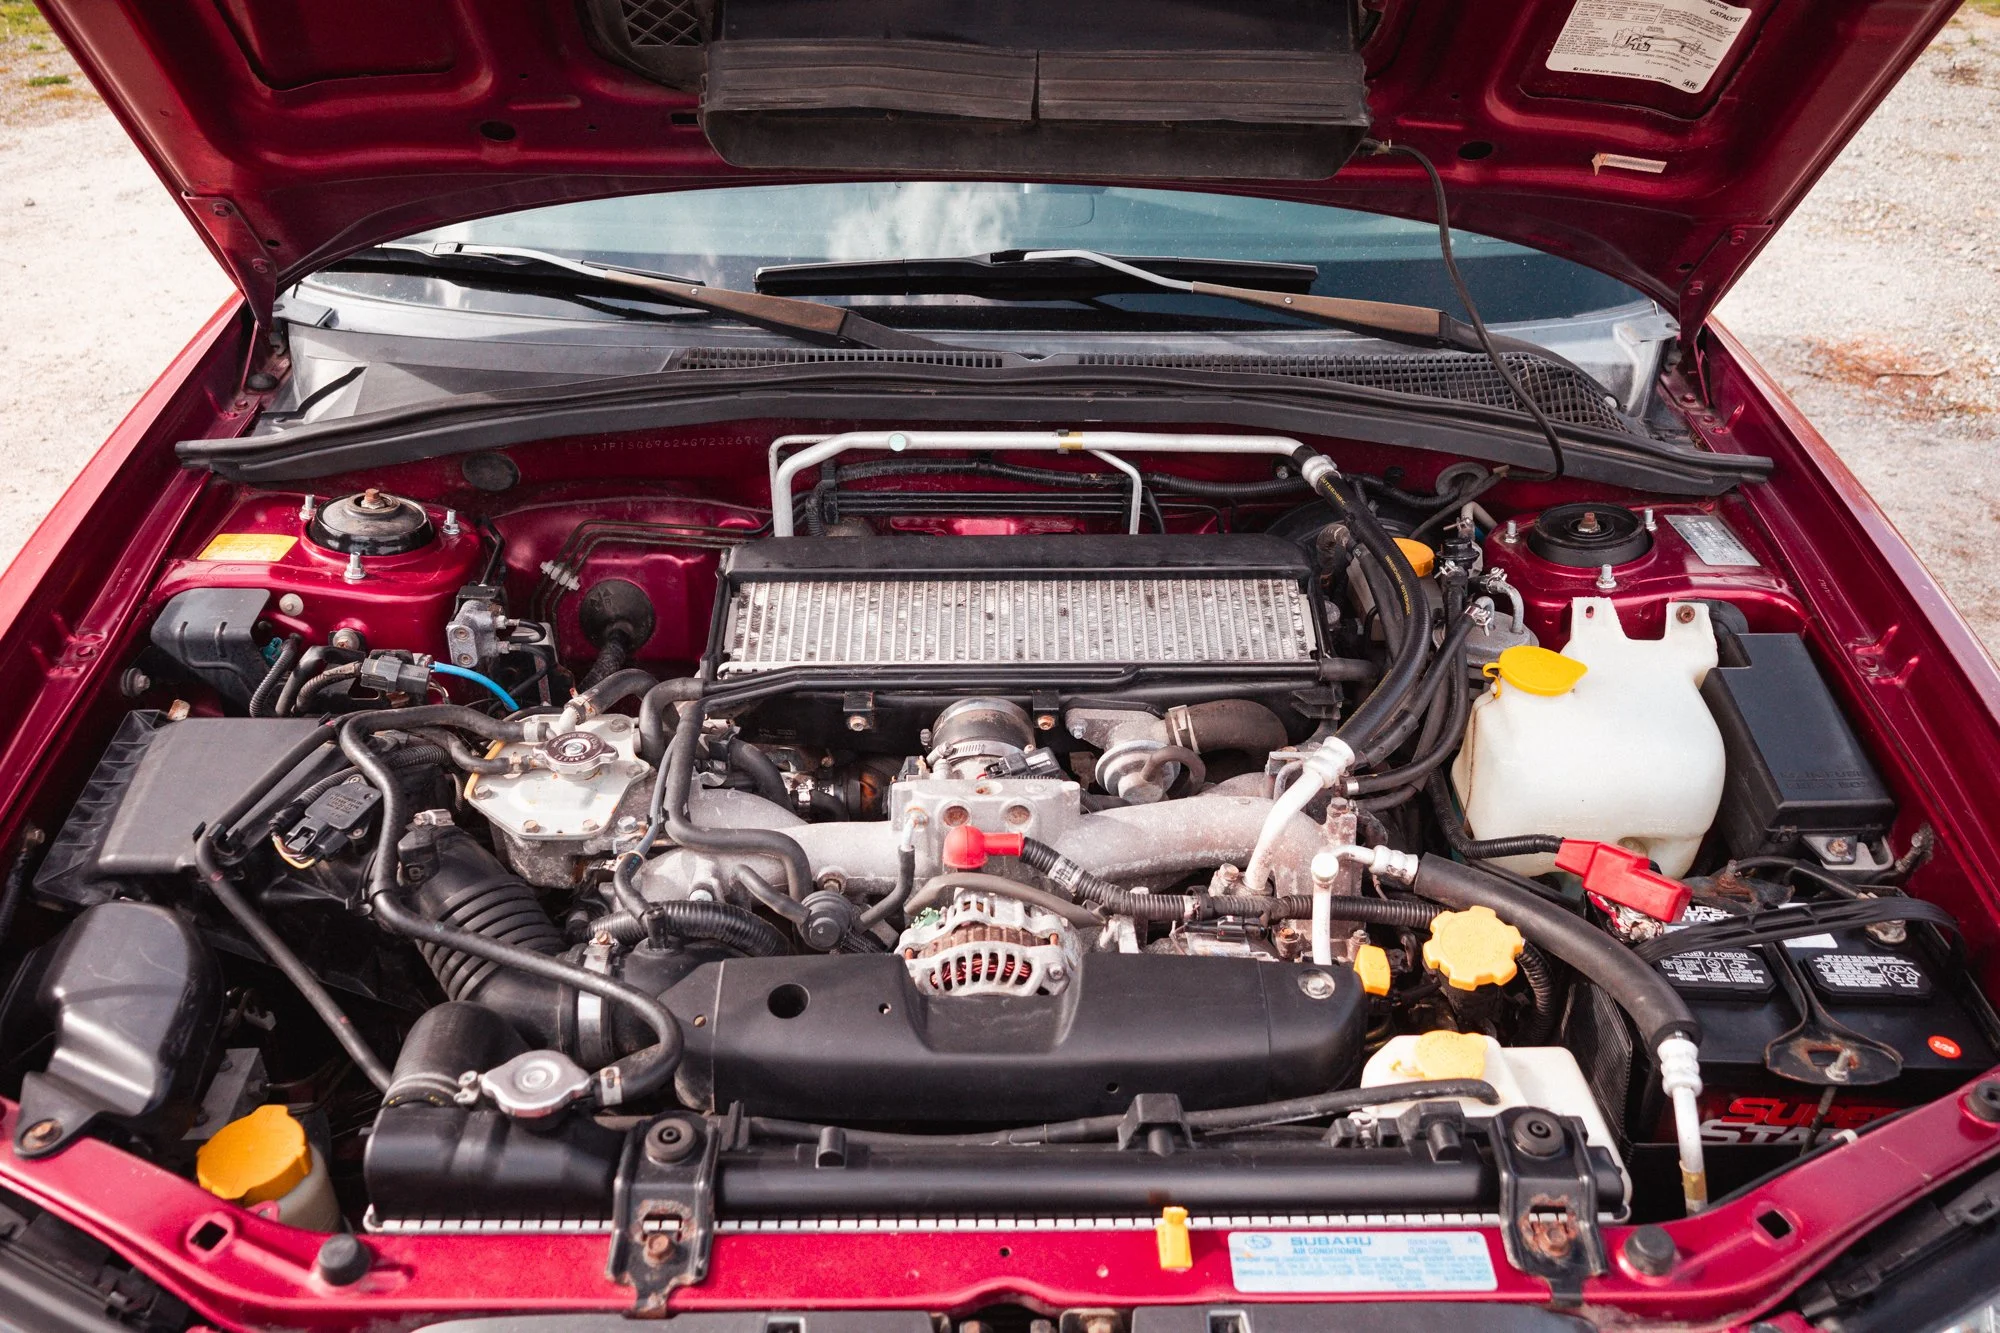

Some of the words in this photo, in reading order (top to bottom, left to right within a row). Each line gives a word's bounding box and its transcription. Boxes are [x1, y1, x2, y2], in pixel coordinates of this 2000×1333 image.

[1709, 9, 1742, 22] CATALYST
[1683, 80, 1697, 89] 4R
[1685, 906, 1727, 914] UPE
[1682, 913, 1735, 922] TAR
[1700, 1119, 1836, 1146] STA
[1290, 1236, 1372, 1246] SUBARU
